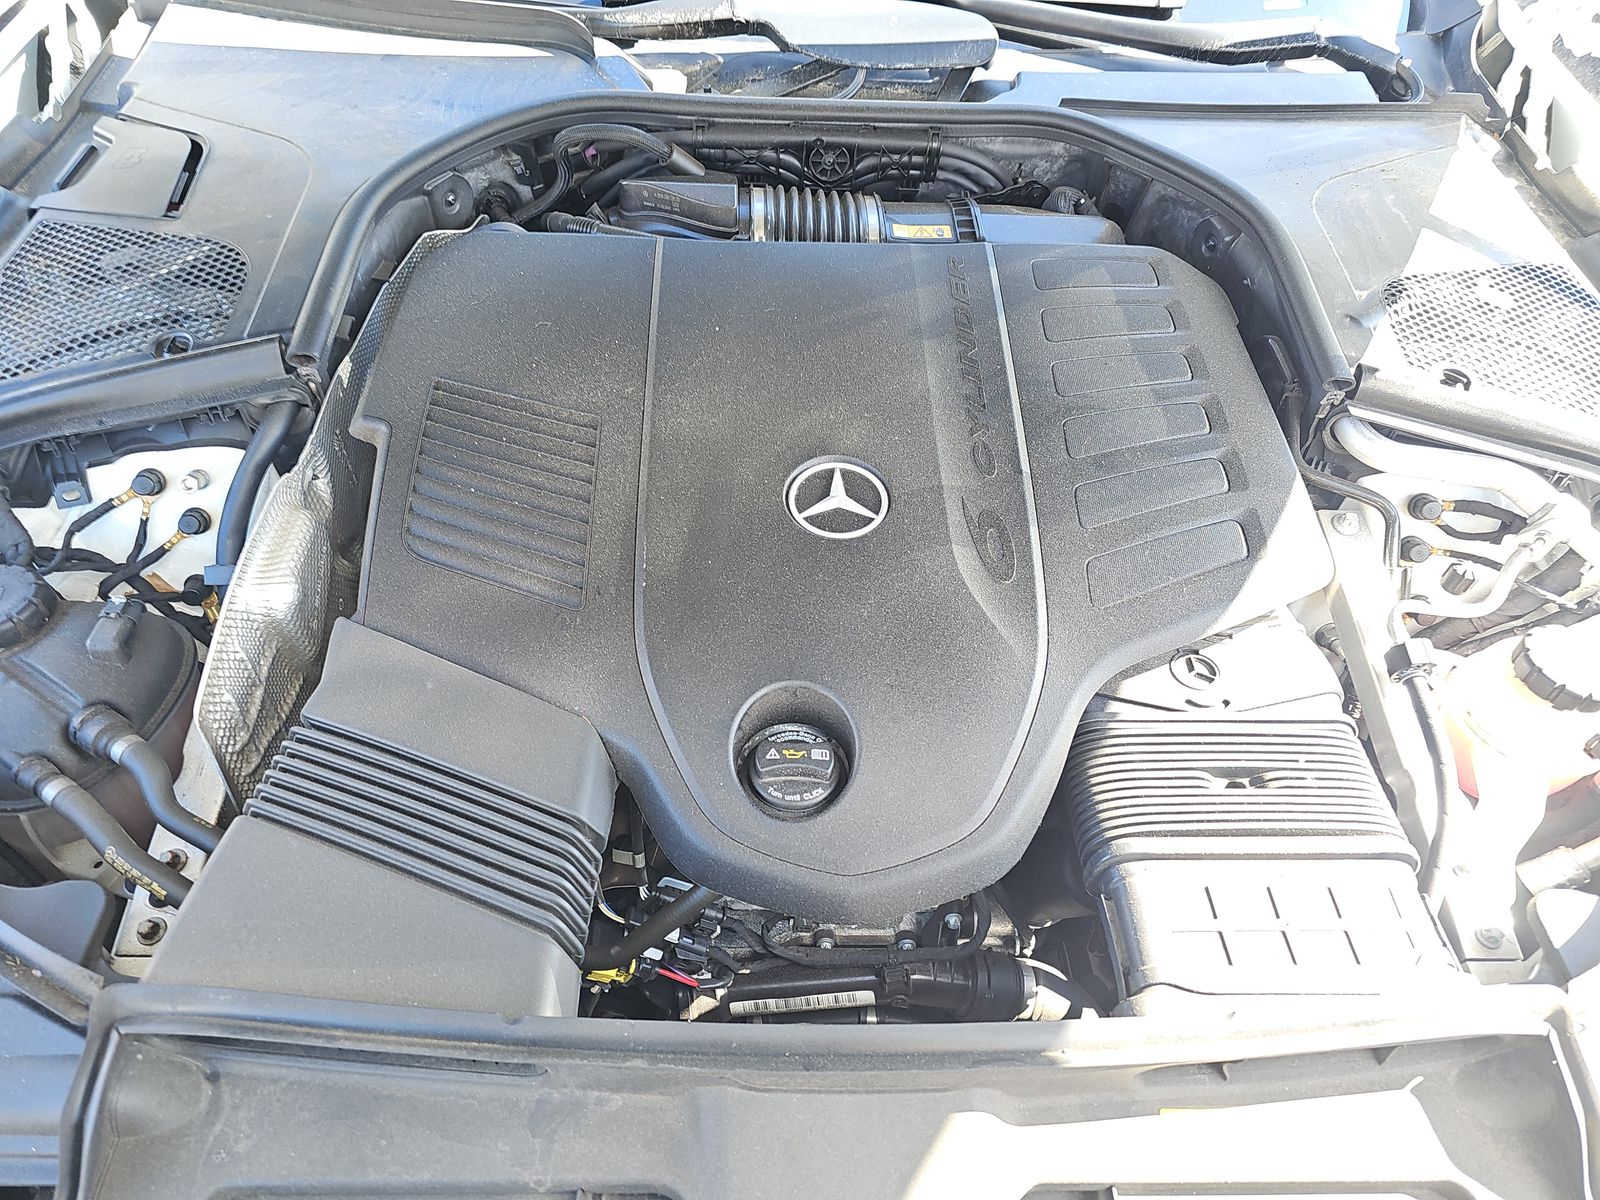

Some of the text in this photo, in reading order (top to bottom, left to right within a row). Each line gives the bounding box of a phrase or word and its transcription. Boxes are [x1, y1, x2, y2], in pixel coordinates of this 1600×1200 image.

[948, 256, 1017, 583] 6 CYLINDER
[767, 786, 783, 799] Turn
[803, 787, 825, 800] CLICK
